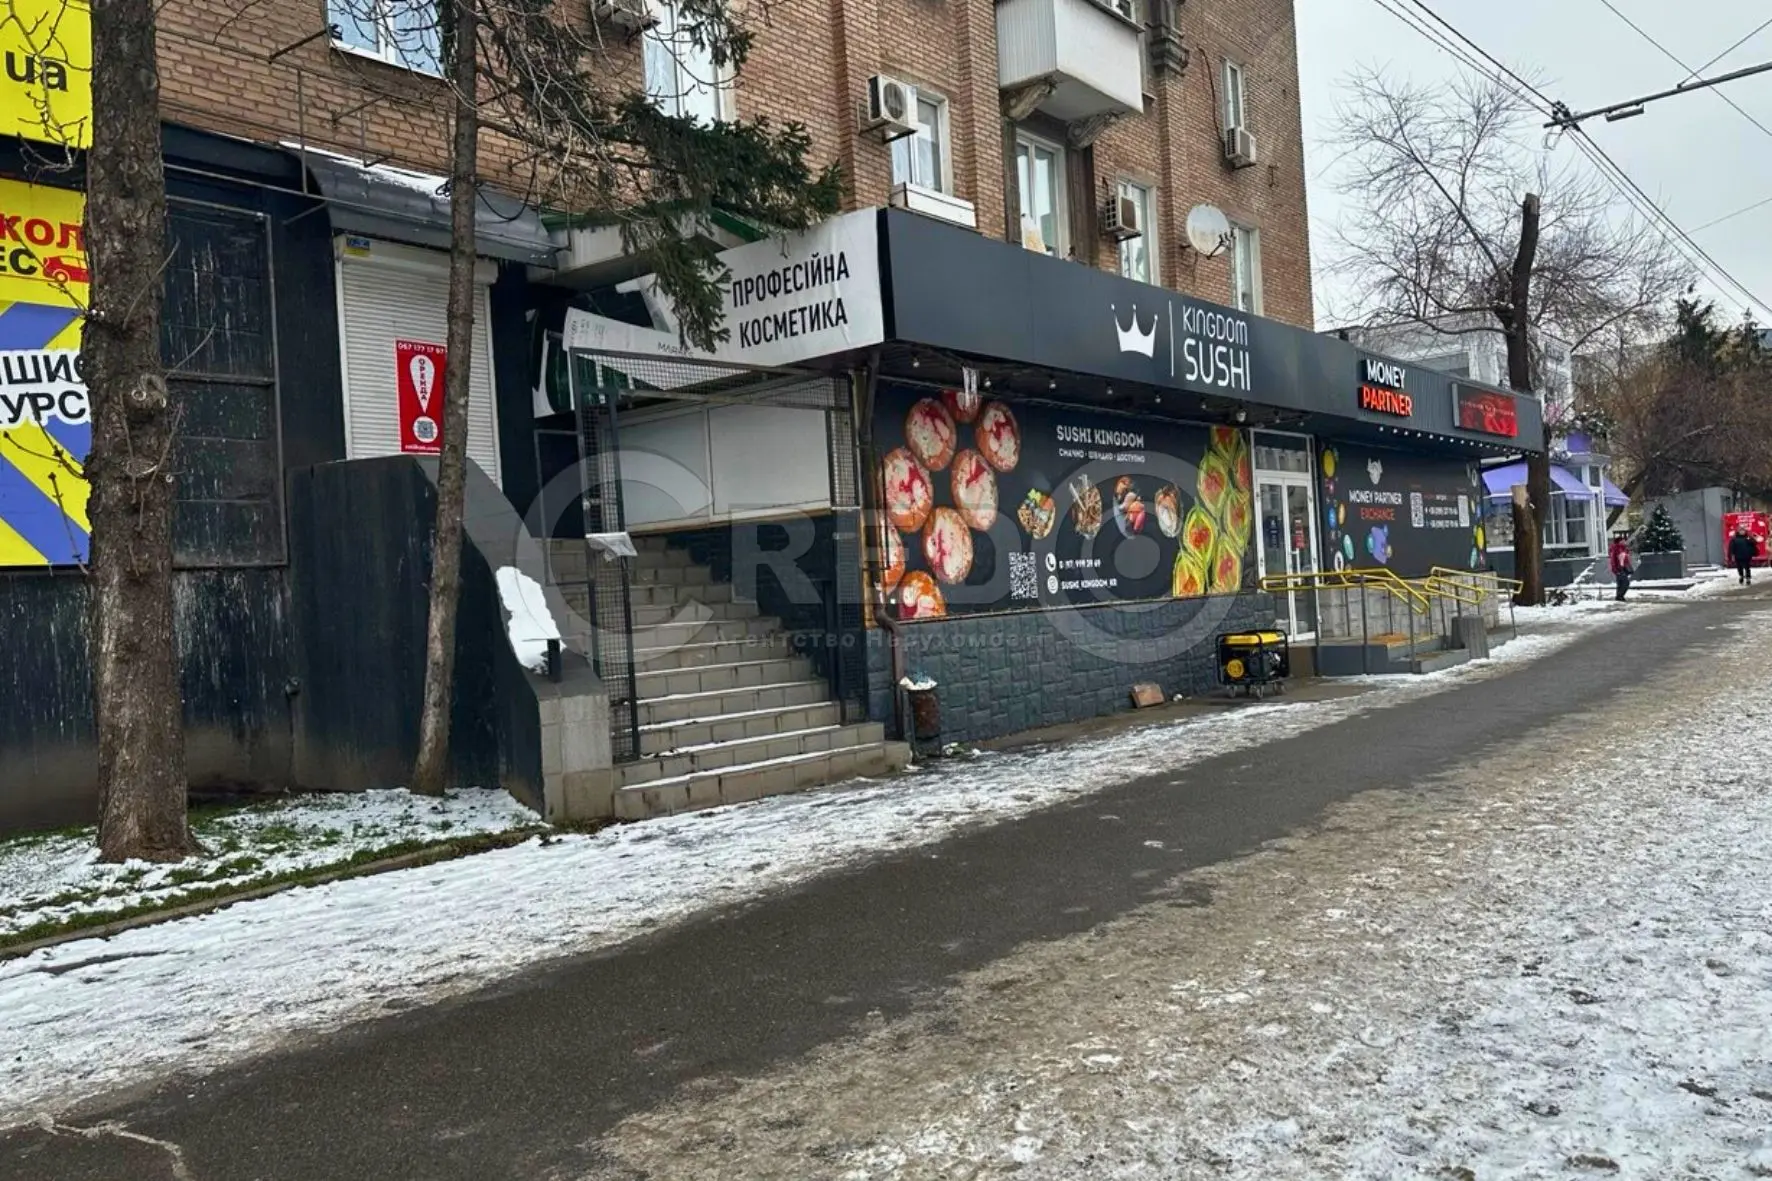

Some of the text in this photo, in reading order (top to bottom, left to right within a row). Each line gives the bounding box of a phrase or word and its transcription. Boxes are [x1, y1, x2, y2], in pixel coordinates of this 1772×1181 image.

[5, 50, 68, 92] ua
[732, 251, 850, 308] ПРОФЕСІЙНА
[739, 297, 848, 349] КОСМЕТИКА
[1182, 304, 1248, 347] KINGDOM
[418, 358, 428, 401] ОРЕНДА
[1183, 337, 1251, 391] SUSHI
[1366, 359, 1405, 389] MONEY
[0, 389, 87, 424] УРС
[1363, 385, 1413, 417] PARTNER
[1056, 425, 1145, 448] SUSHI KINGDOM
[1349, 489, 1402, 505] MONEY PARTNER
